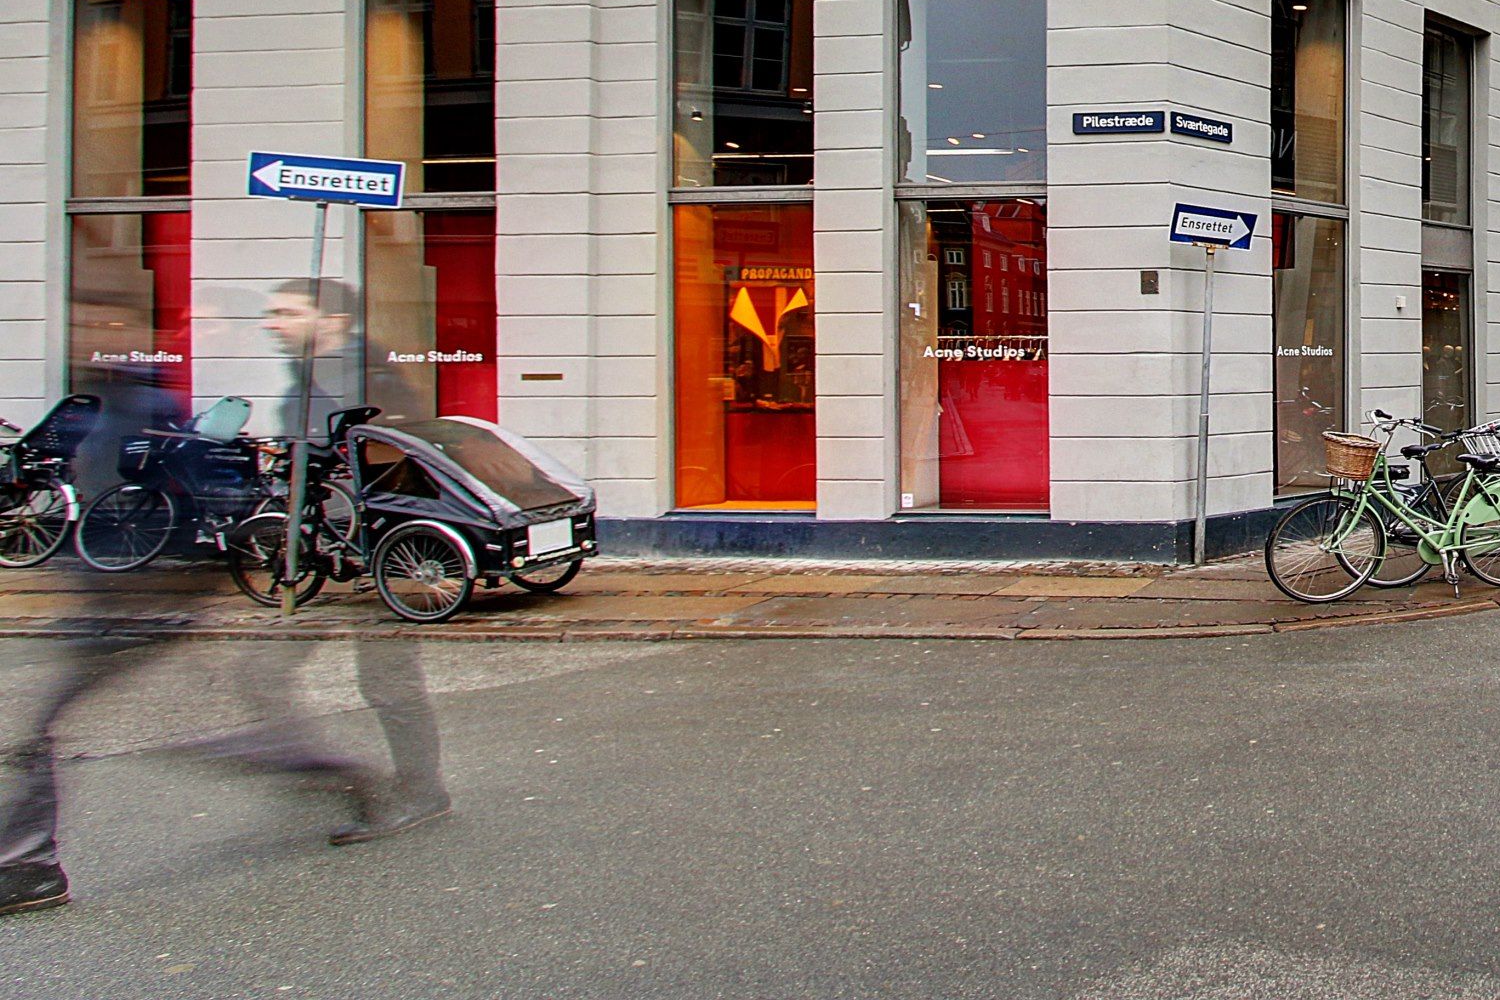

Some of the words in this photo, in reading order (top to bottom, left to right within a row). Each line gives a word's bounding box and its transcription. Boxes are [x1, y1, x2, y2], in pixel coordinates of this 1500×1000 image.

[1082, 115, 1154, 128] Pilestræde
[1175, 115, 1229, 137] Sværtegade
[279, 168, 389, 192] Ensrettet
[1181, 216, 1234, 234] Ensrettet
[91, 351, 128, 362] Acne
[129, 350, 183, 362] Studios
[387, 350, 426, 362] Acne
[427, 349, 483, 362] Studios
[923, 345, 964, 358] Acne
[967, 344, 1026, 358] Studios
[1277, 345, 1300, 356] Acne
[1301, 345, 1333, 356] Studios
